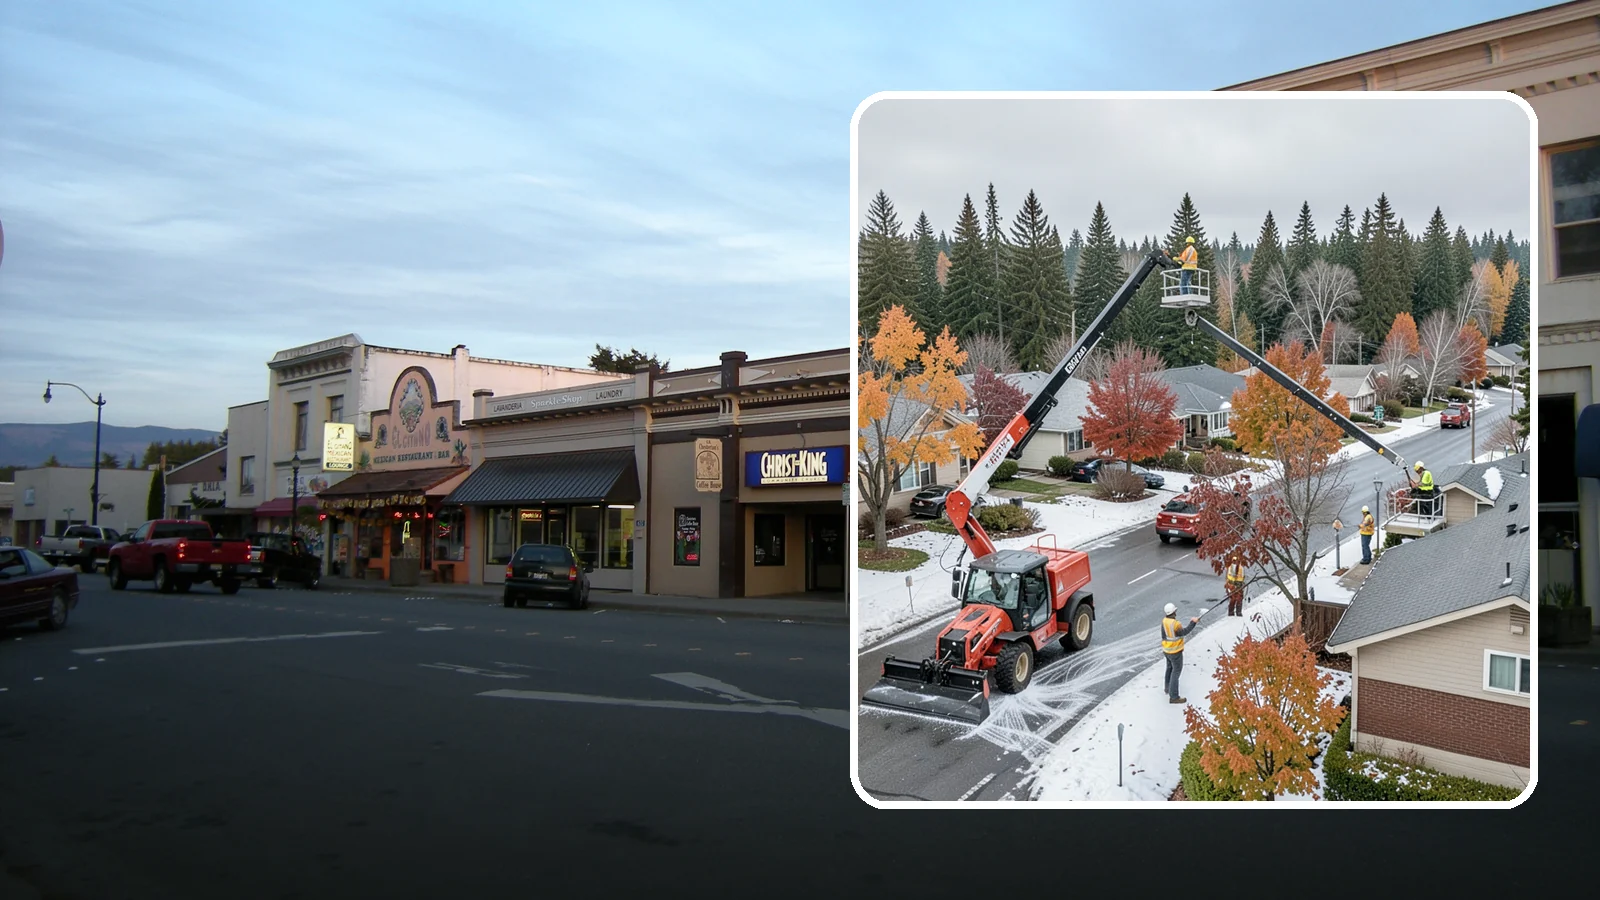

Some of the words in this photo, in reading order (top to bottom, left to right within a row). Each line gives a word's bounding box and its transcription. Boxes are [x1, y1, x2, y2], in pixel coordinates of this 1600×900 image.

[595, 389, 623, 400] LAUNDRY
[493, 402, 522, 412] LAVANDERIA
[531, 398, 559, 409] Sparkle
[561, 394, 582, 404] Shop
[374, 455, 396, 464] MEXICAN
[397, 451, 433, 462] RESTAURANT
[438, 449, 450, 459] BAR
[761, 452, 797, 478] CHRIST
[799, 450, 827, 477] KING
[697, 481, 709, 489] Coffee
